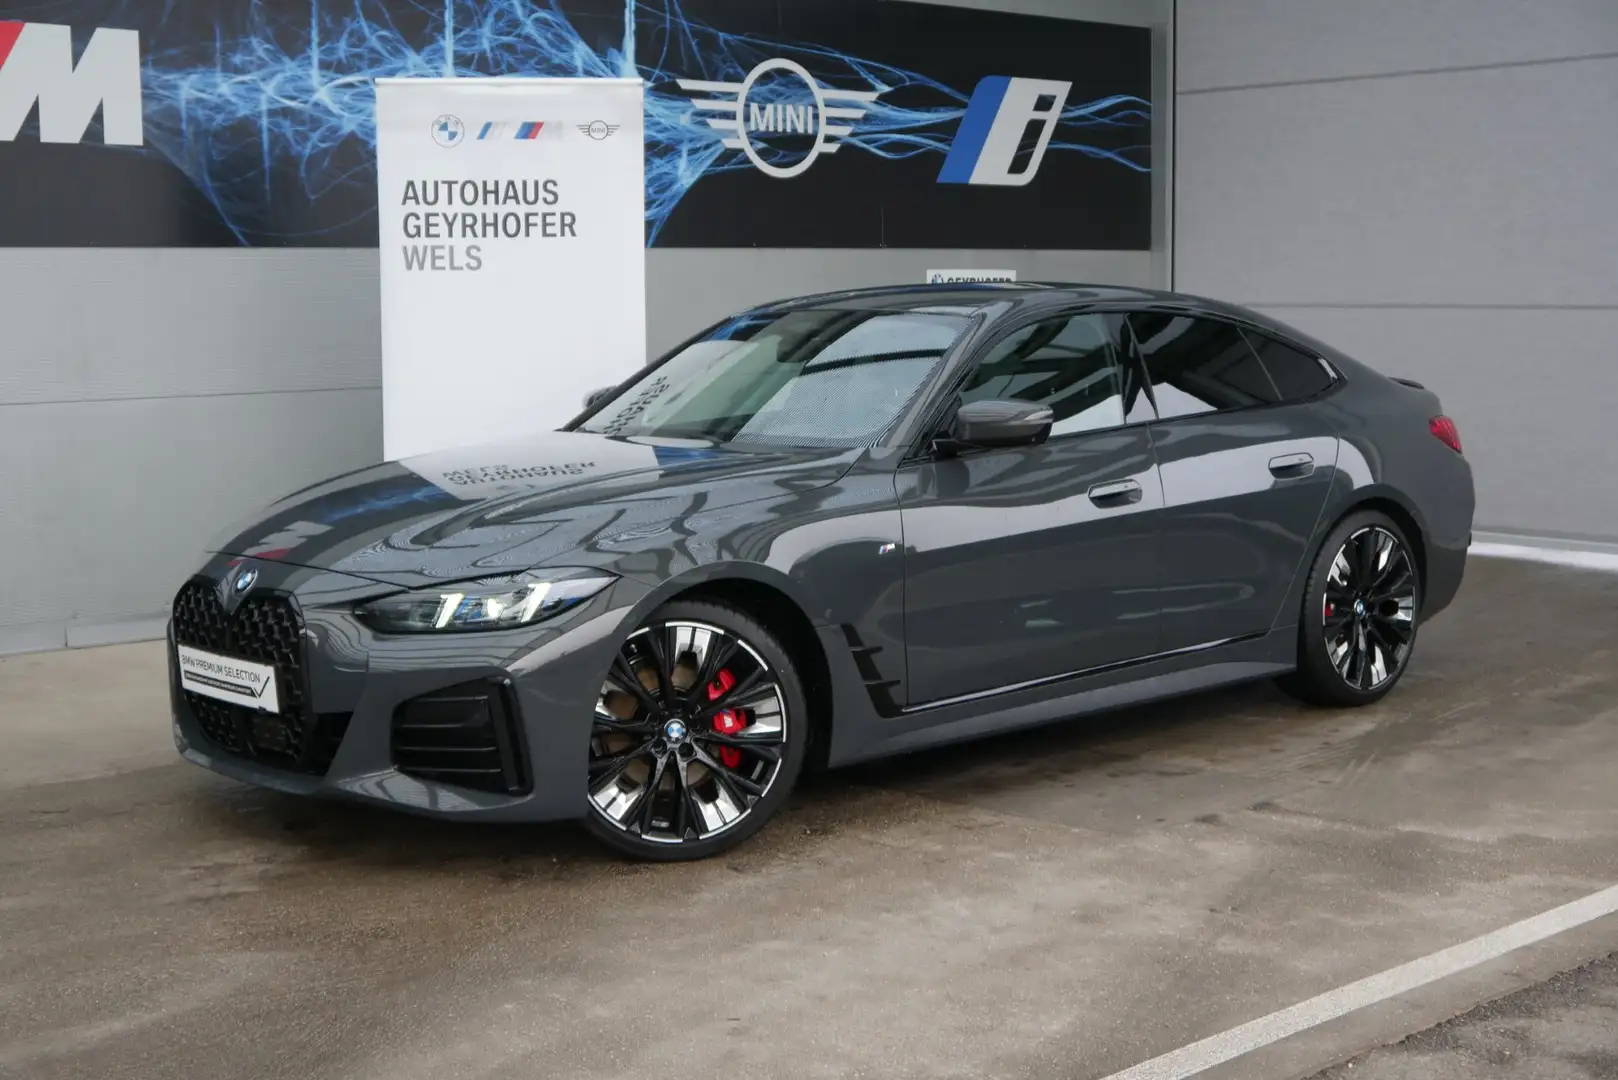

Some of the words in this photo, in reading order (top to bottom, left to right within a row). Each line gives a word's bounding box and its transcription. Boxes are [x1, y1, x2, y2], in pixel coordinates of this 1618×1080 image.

[0, 22, 143, 146] M
[749, 103, 813, 134] MINI
[401, 179, 559, 206] AUTOHAUS
[402, 211, 577, 238] GEYRHOFER
[402, 244, 482, 271] WELS
[181, 654, 196, 668] BMW
[196, 658, 223, 675] PREMIUM
[223, 665, 261, 684] SELECTION
